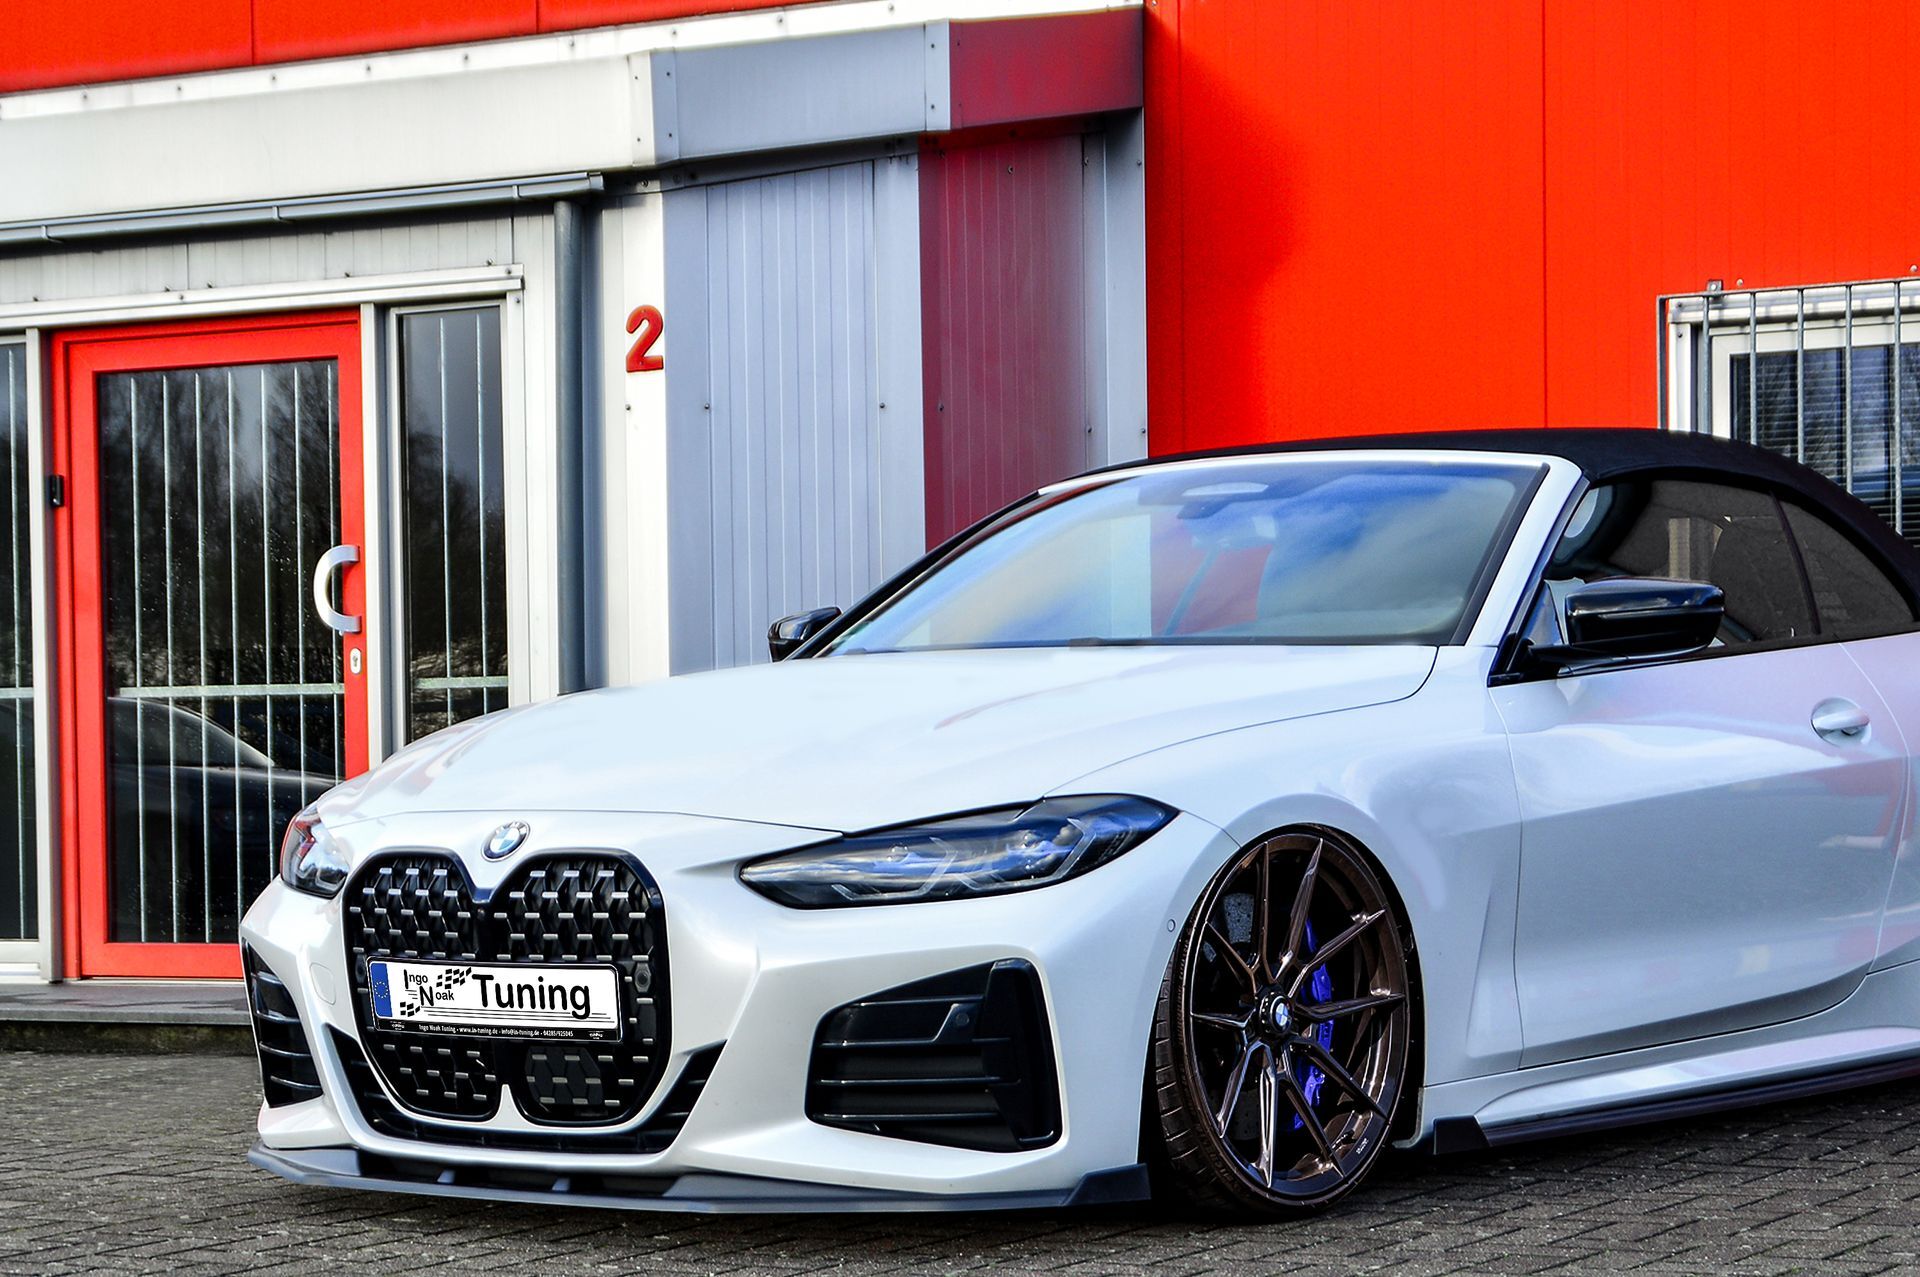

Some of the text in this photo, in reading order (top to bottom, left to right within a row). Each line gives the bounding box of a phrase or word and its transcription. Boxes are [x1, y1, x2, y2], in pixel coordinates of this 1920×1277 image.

[626, 304, 664, 373] 2
[403, 969, 429, 990] Ingo
[419, 985, 455, 1007] Noak
[472, 973, 591, 1020] Tuning
[418, 1024, 429, 1032] Ingo
[429, 1024, 441, 1032] Noak
[441, 1025, 456, 1034] Tuning
